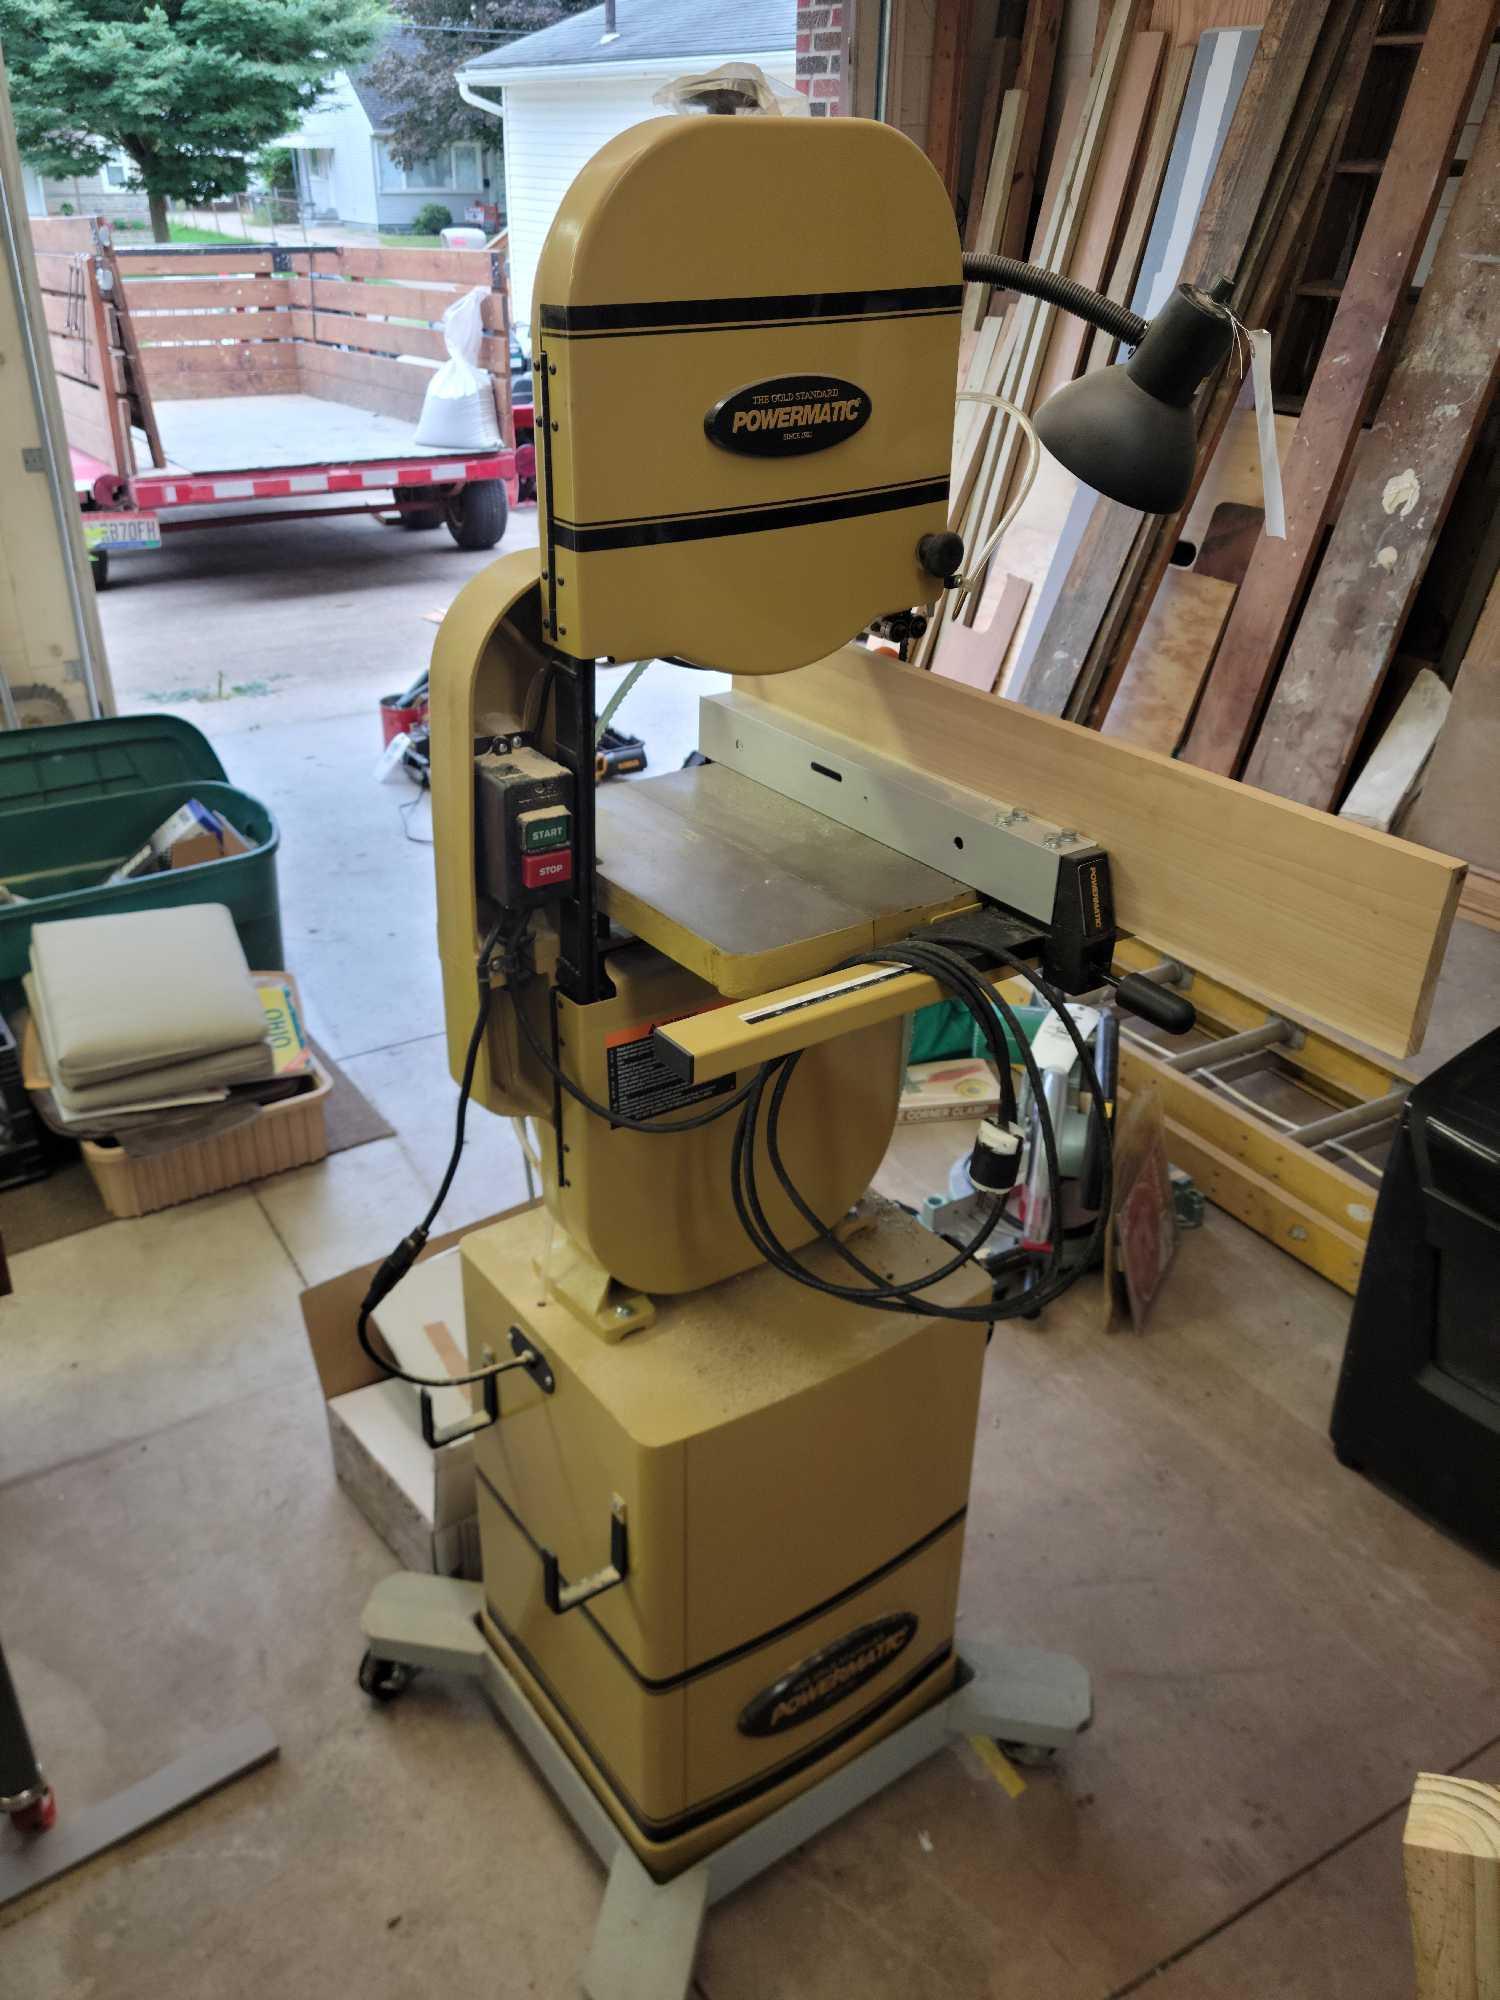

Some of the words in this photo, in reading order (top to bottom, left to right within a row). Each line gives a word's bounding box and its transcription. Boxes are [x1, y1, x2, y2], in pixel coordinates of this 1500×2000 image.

[752, 395, 770, 405] THE
[771, 392, 794, 404] GOLD
[795, 389, 839, 400] STANDARD
[732, 399, 860, 434] POWERMATIC
[532, 827, 563, 841] START
[539, 864, 563, 876] STOP
[1090, 865, 1101, 928] POWERMATIC
[264, 1007, 291, 1048] OHIO
[769, 1630, 906, 1727] POWERMATIC
